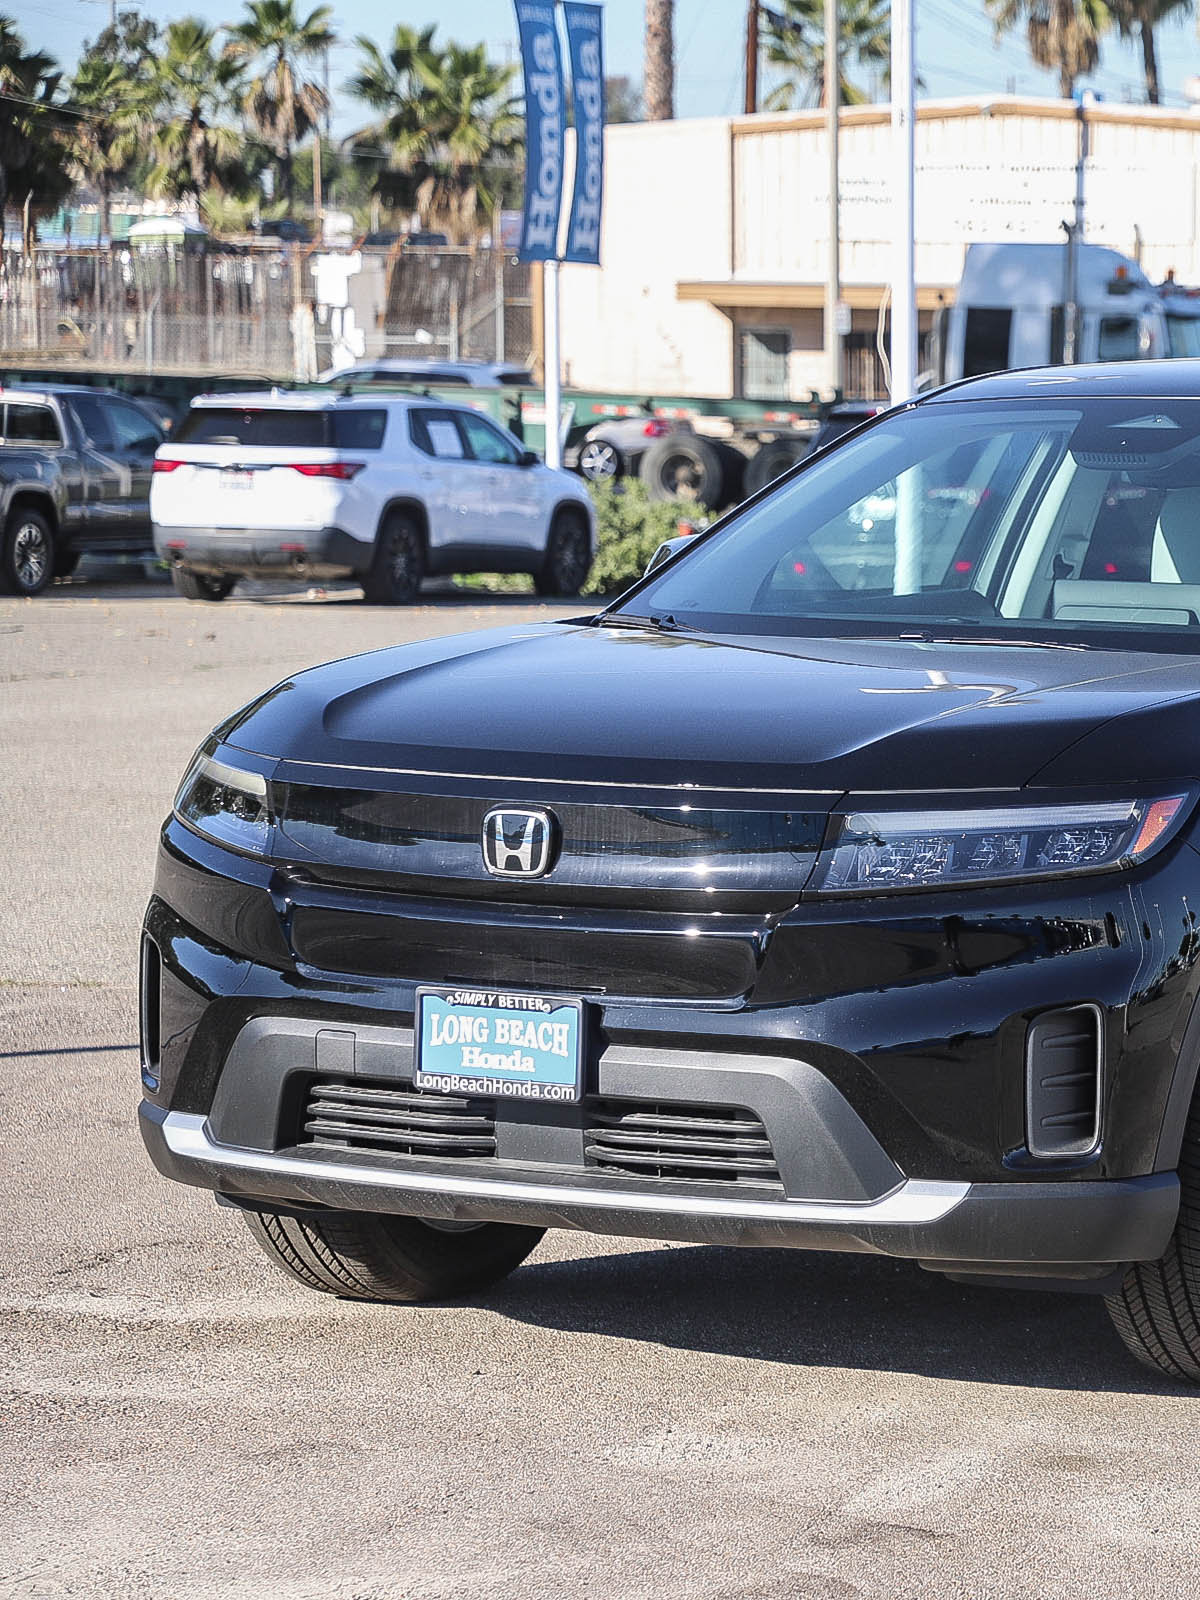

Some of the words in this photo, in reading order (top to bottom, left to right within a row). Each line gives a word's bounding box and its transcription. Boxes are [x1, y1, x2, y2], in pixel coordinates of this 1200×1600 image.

[453, 991, 496, 1007] SIMPLY
[499, 995, 544, 1012] BETTER
[429, 1013, 490, 1047] LONG
[494, 1017, 570, 1057] BEACH
[460, 1045, 536, 1073] Honda
[416, 1070, 575, 1100] LongBeachHonda.com
